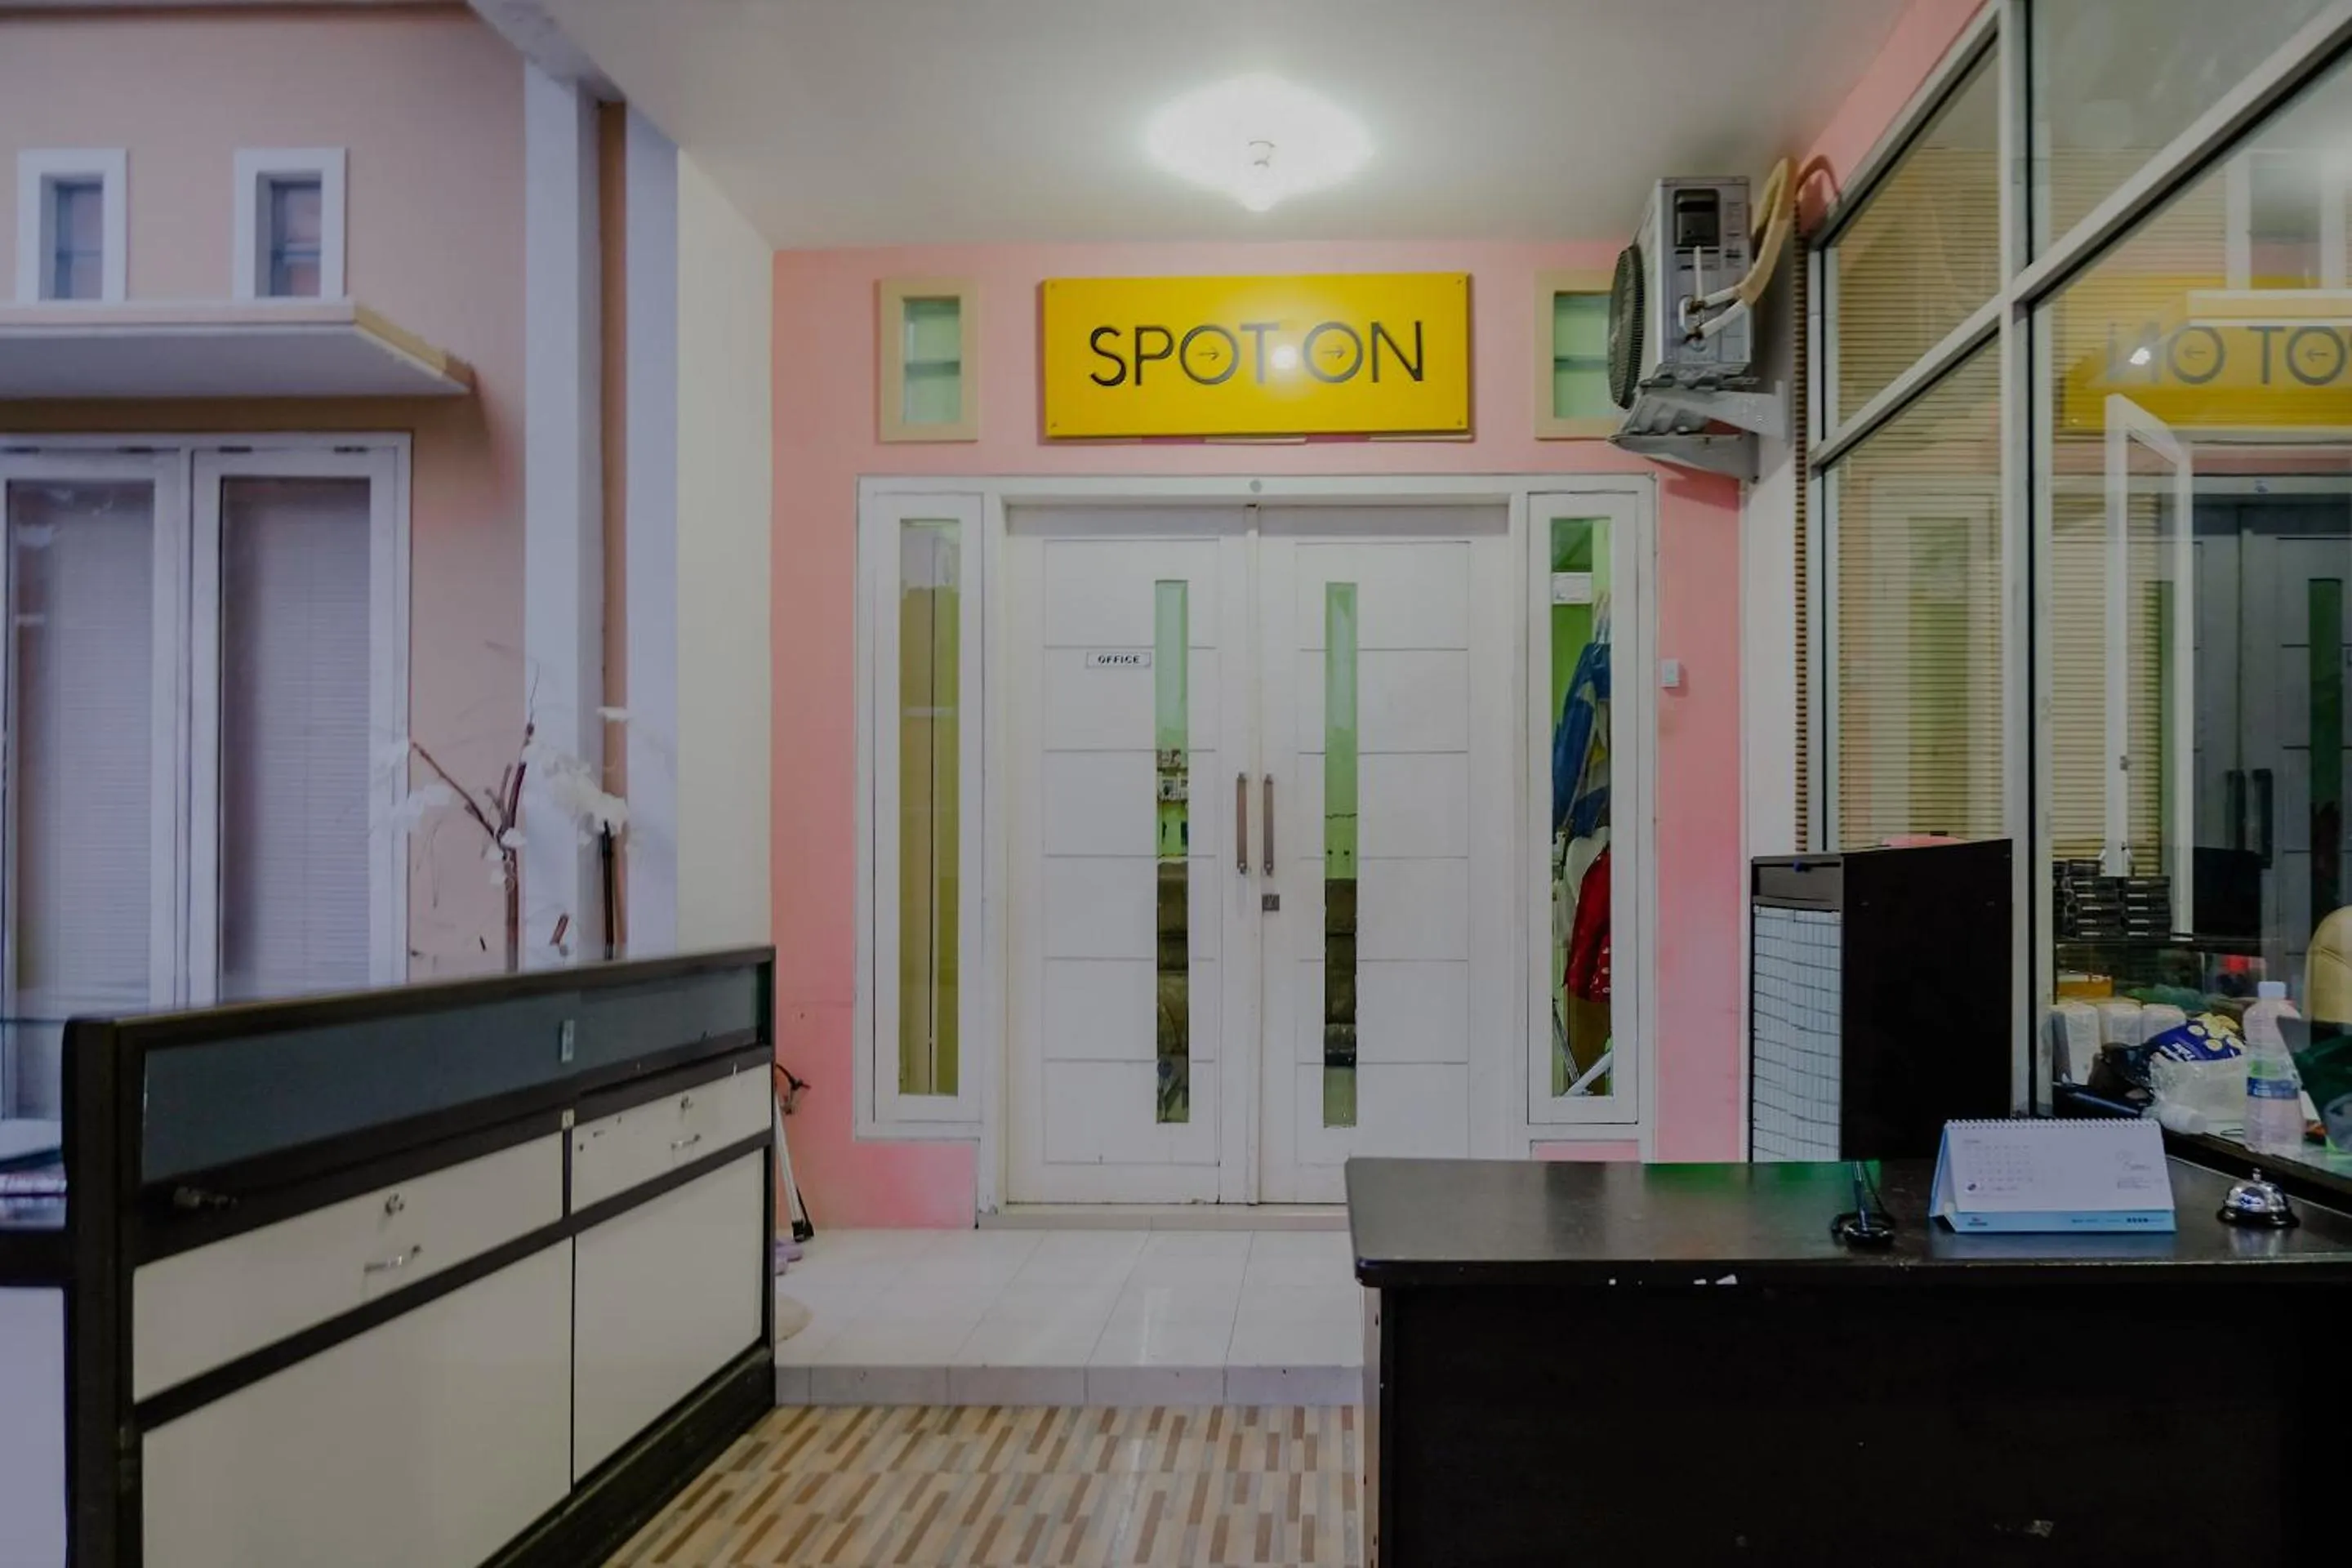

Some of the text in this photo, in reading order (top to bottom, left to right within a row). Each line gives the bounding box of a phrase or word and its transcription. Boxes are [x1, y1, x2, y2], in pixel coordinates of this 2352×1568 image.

[1089, 320, 1425, 387] SPOT ON
[1097, 654, 1141, 664] OFFICE
